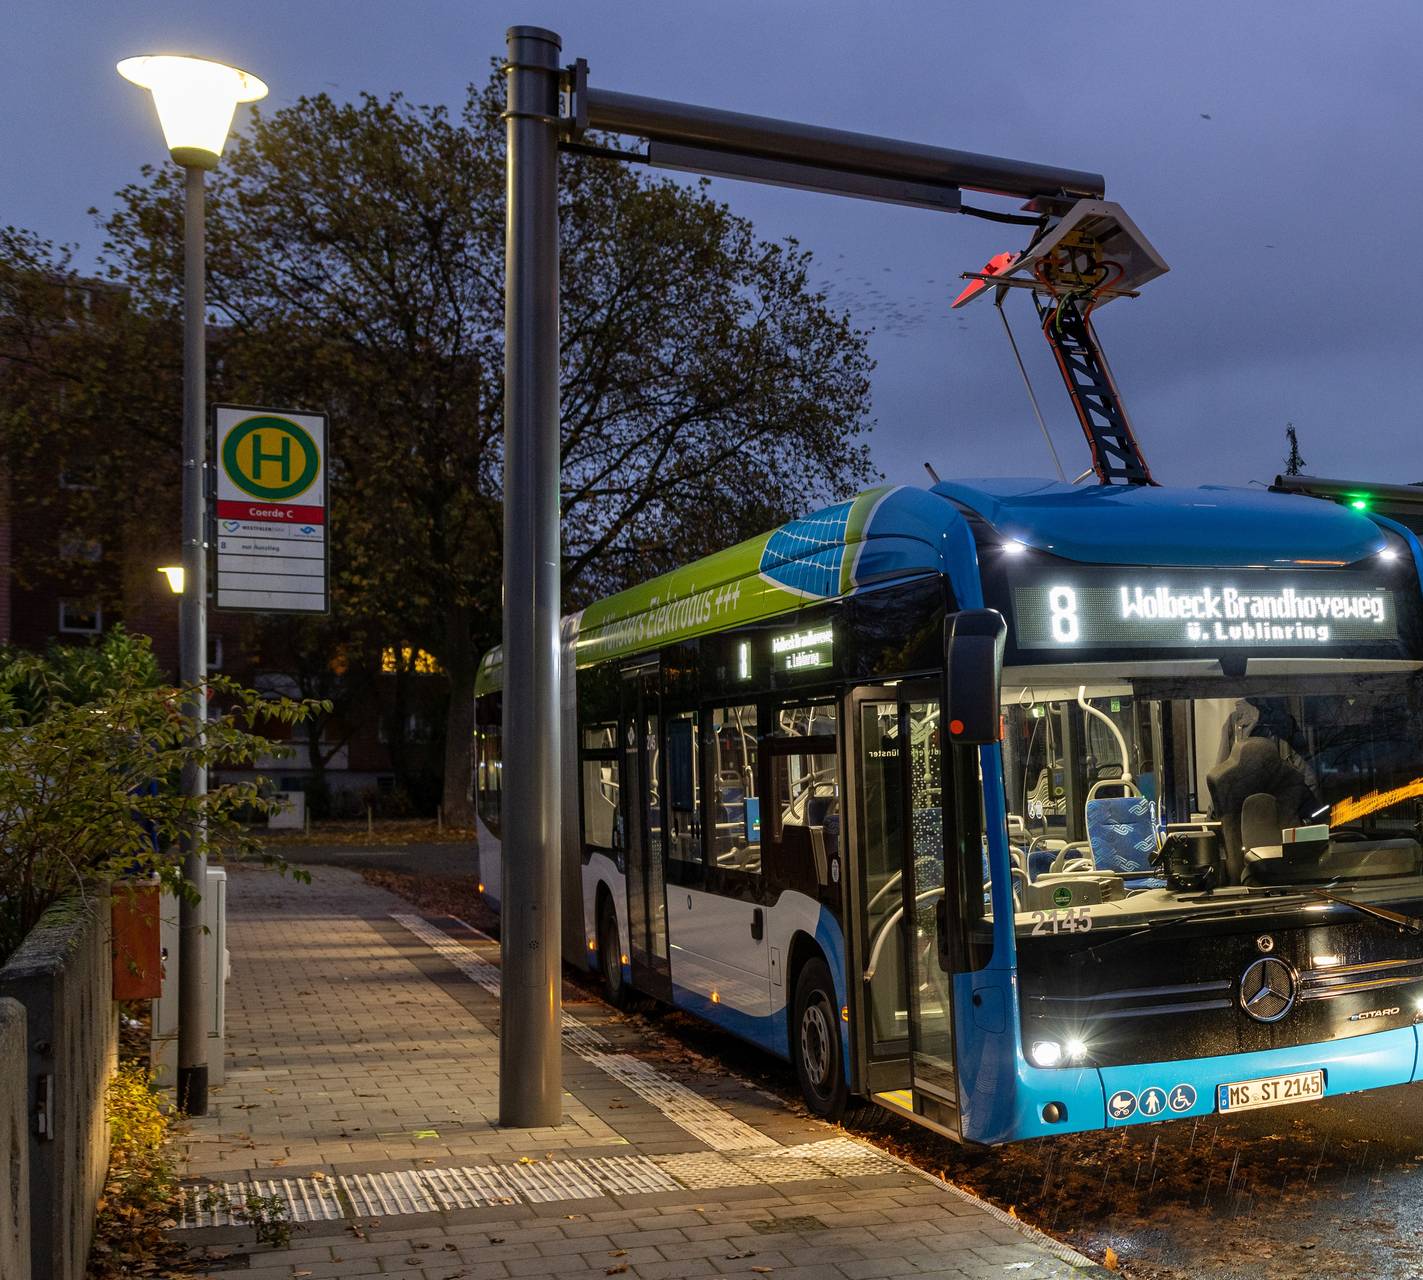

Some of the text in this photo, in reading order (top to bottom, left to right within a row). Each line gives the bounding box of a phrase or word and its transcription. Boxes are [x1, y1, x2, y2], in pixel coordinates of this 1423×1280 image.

[252, 434, 290, 482] H
[249, 508, 294, 518] Coerde C
[646, 583, 715, 638] Elektrobus
[1049, 586, 1079, 642] 8
[1120, 586, 1385, 622] Wolbeck Brandhoveweg
[1214, 622, 1329, 641] Lublinring
[1031, 908, 1093, 935] 2145
[1230, 1086, 1250, 1106] MS
[1262, 1081, 1280, 1101] ST
[1284, 1075, 1320, 1098] 2145
